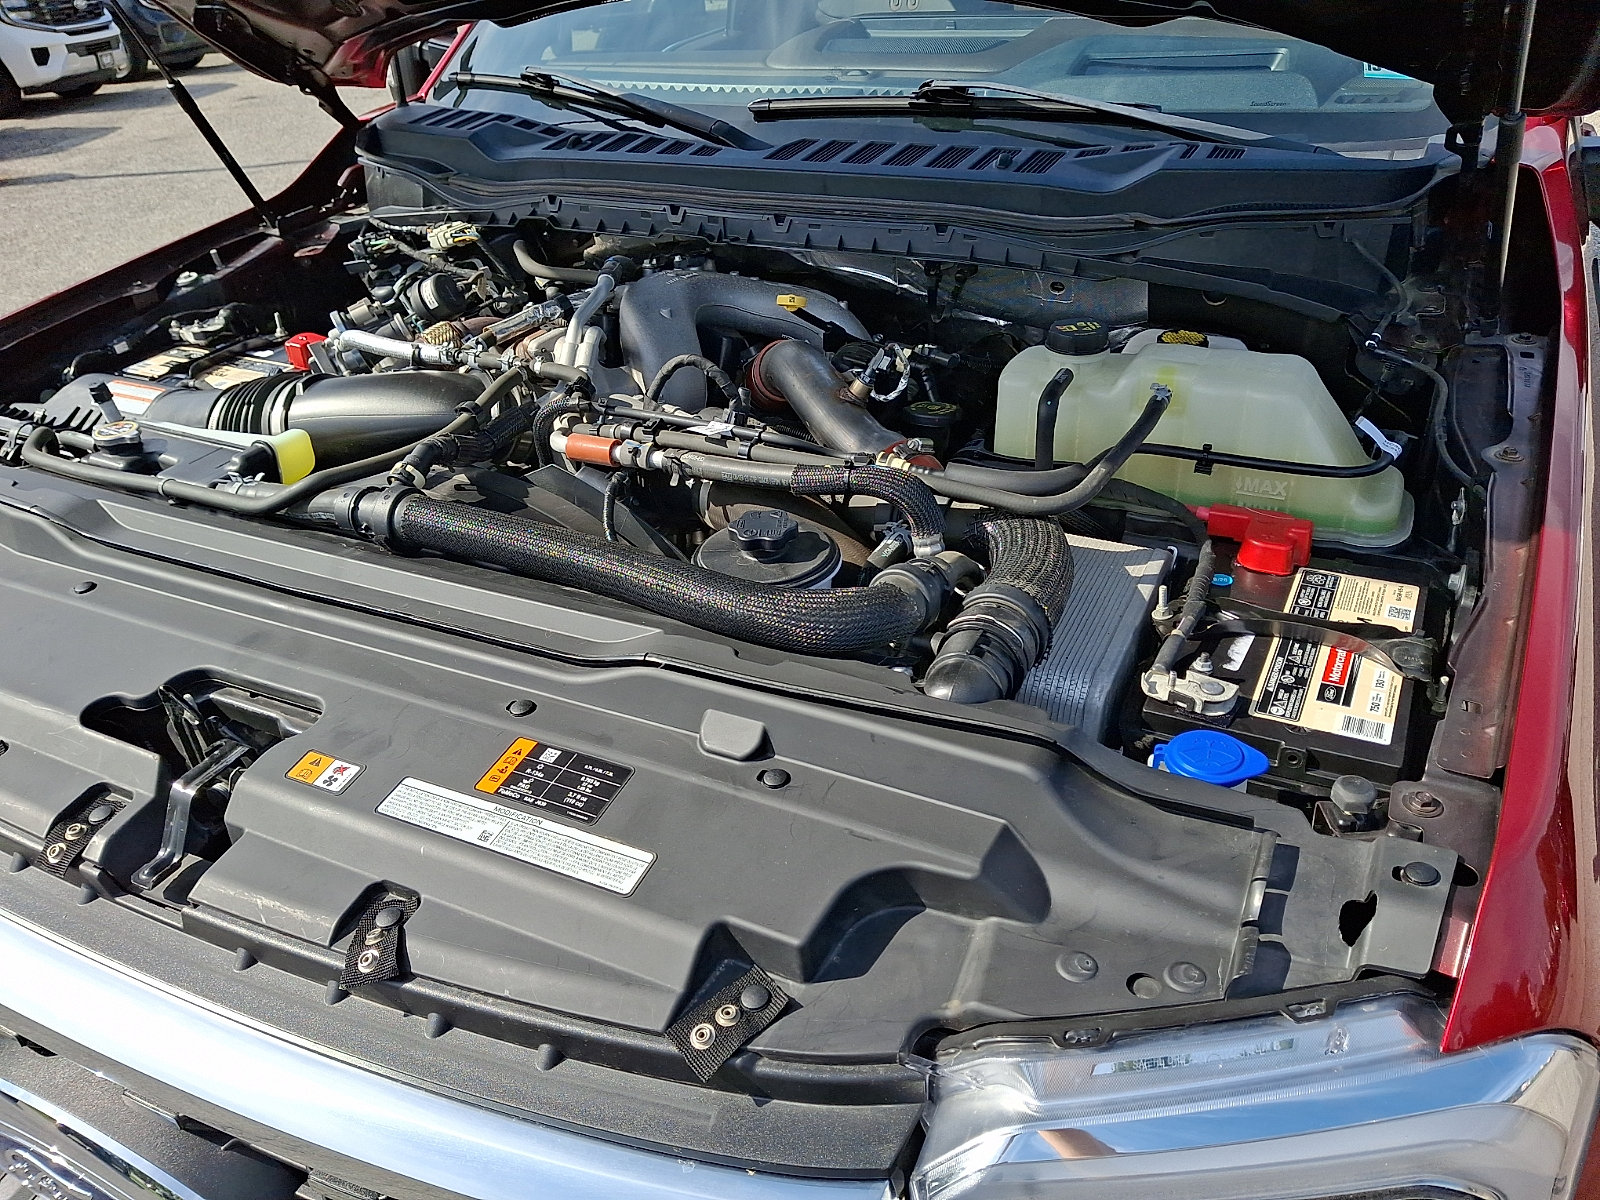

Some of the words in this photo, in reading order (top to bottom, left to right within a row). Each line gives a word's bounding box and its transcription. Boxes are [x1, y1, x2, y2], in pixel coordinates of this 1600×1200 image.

[1243, 478, 1287, 497] MAX
[1329, 648, 1347, 682] Motorcraf
[493, 806, 543, 826] MODIFICATION
